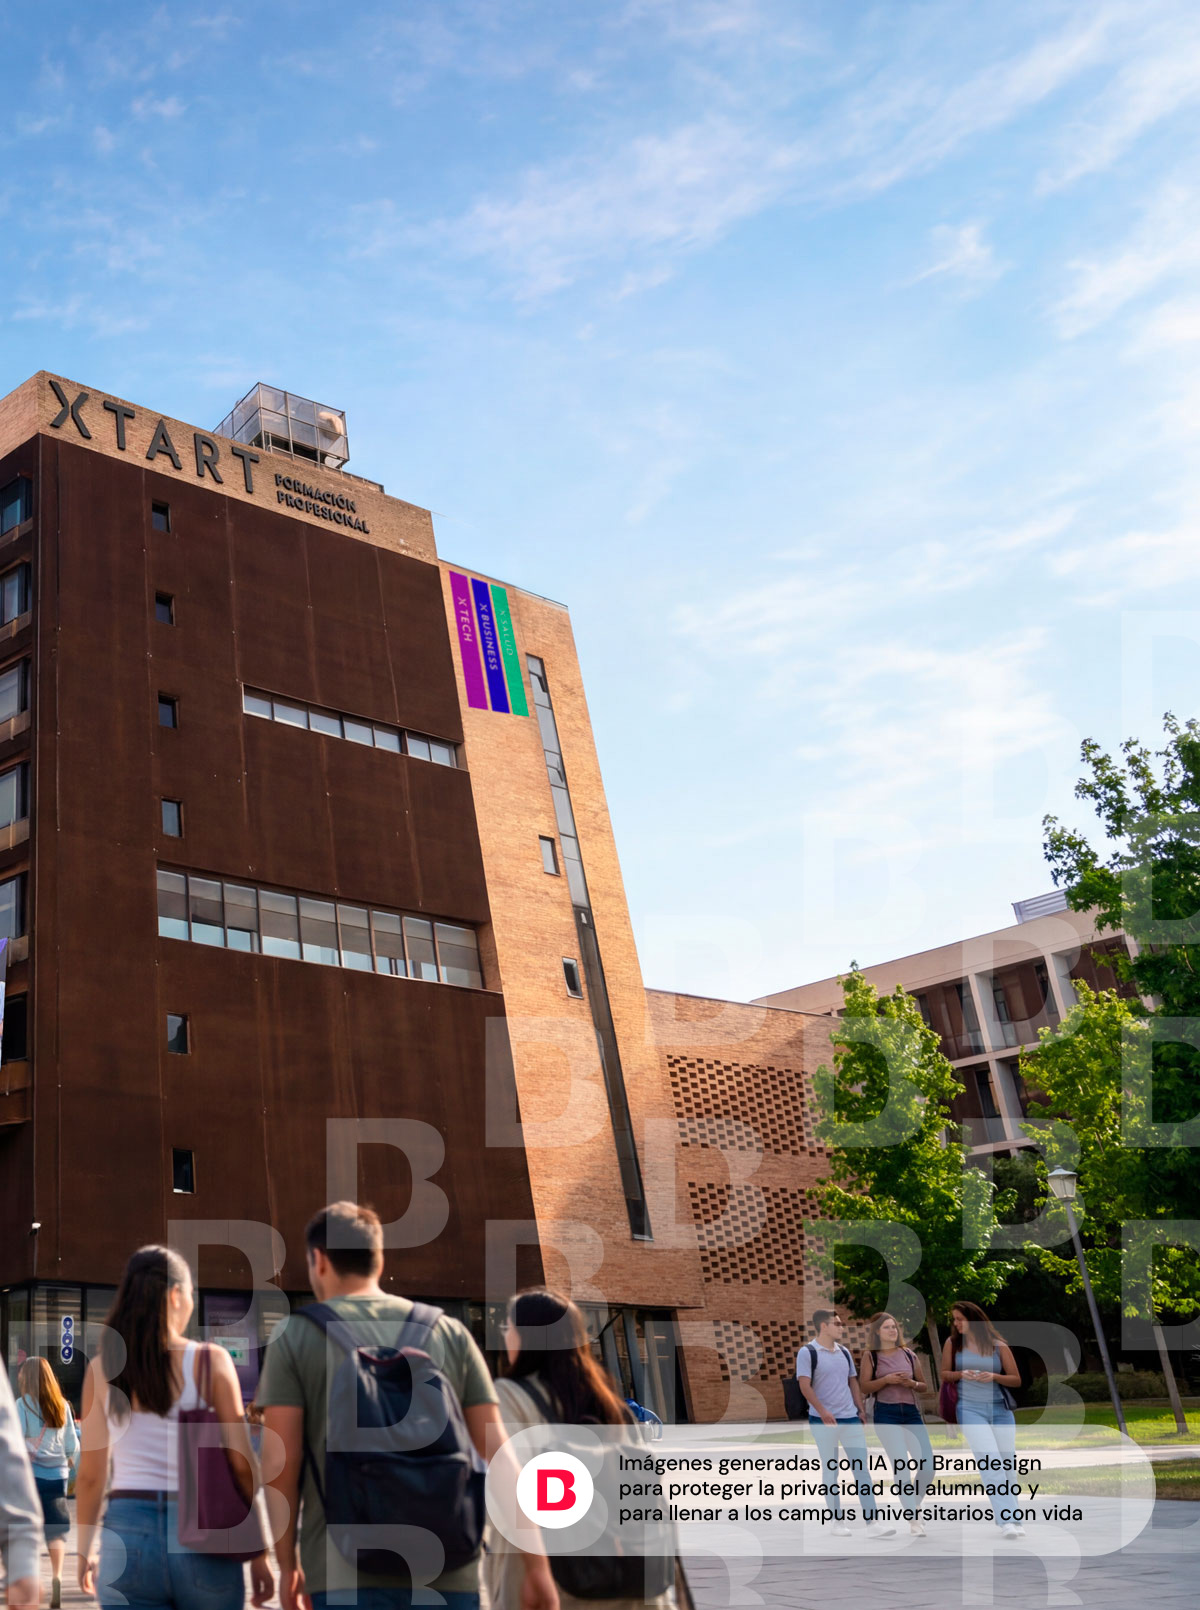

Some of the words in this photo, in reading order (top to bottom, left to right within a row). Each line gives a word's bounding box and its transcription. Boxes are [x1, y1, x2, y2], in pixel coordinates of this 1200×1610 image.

[48, 379, 260, 494] XTART
[275, 473, 357, 514] FORMACIÓN
[277, 490, 371, 534] PROFESIONAL
[460, 609, 473, 642] TECH
[481, 614, 498, 670] BUSINESS
